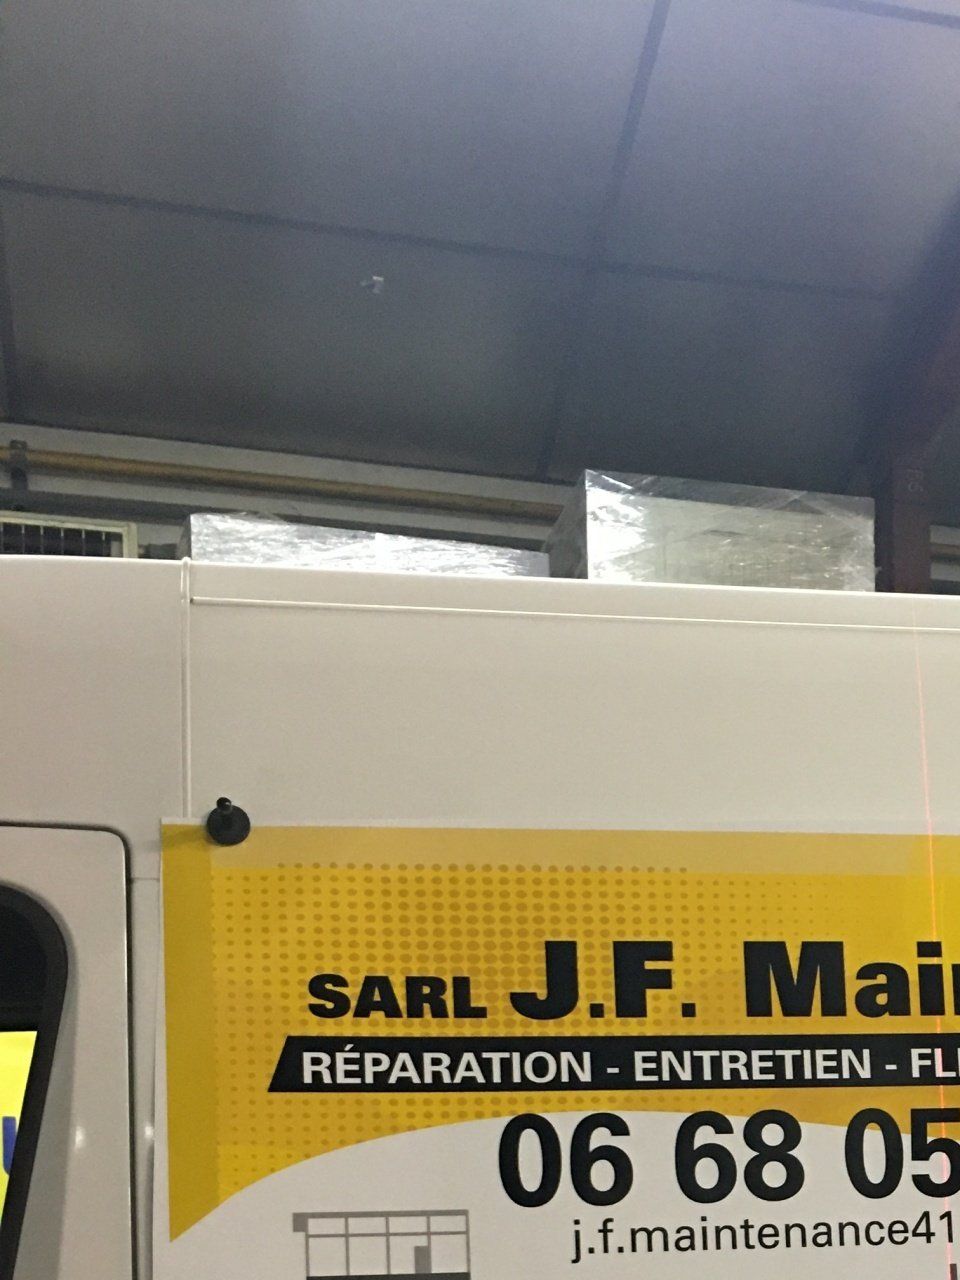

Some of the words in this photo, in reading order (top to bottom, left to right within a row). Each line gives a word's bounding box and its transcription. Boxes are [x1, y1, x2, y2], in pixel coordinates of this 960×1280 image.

[307, 973, 488, 1019] SARL
[509, 940, 697, 1021] J.F.
[301, 1044, 593, 1085] RÉPARATION
[633, 1045, 872, 1083] ENTRETIEN
[498, 1111, 634, 1208] 06
[674, 1108, 806, 1204] 68
